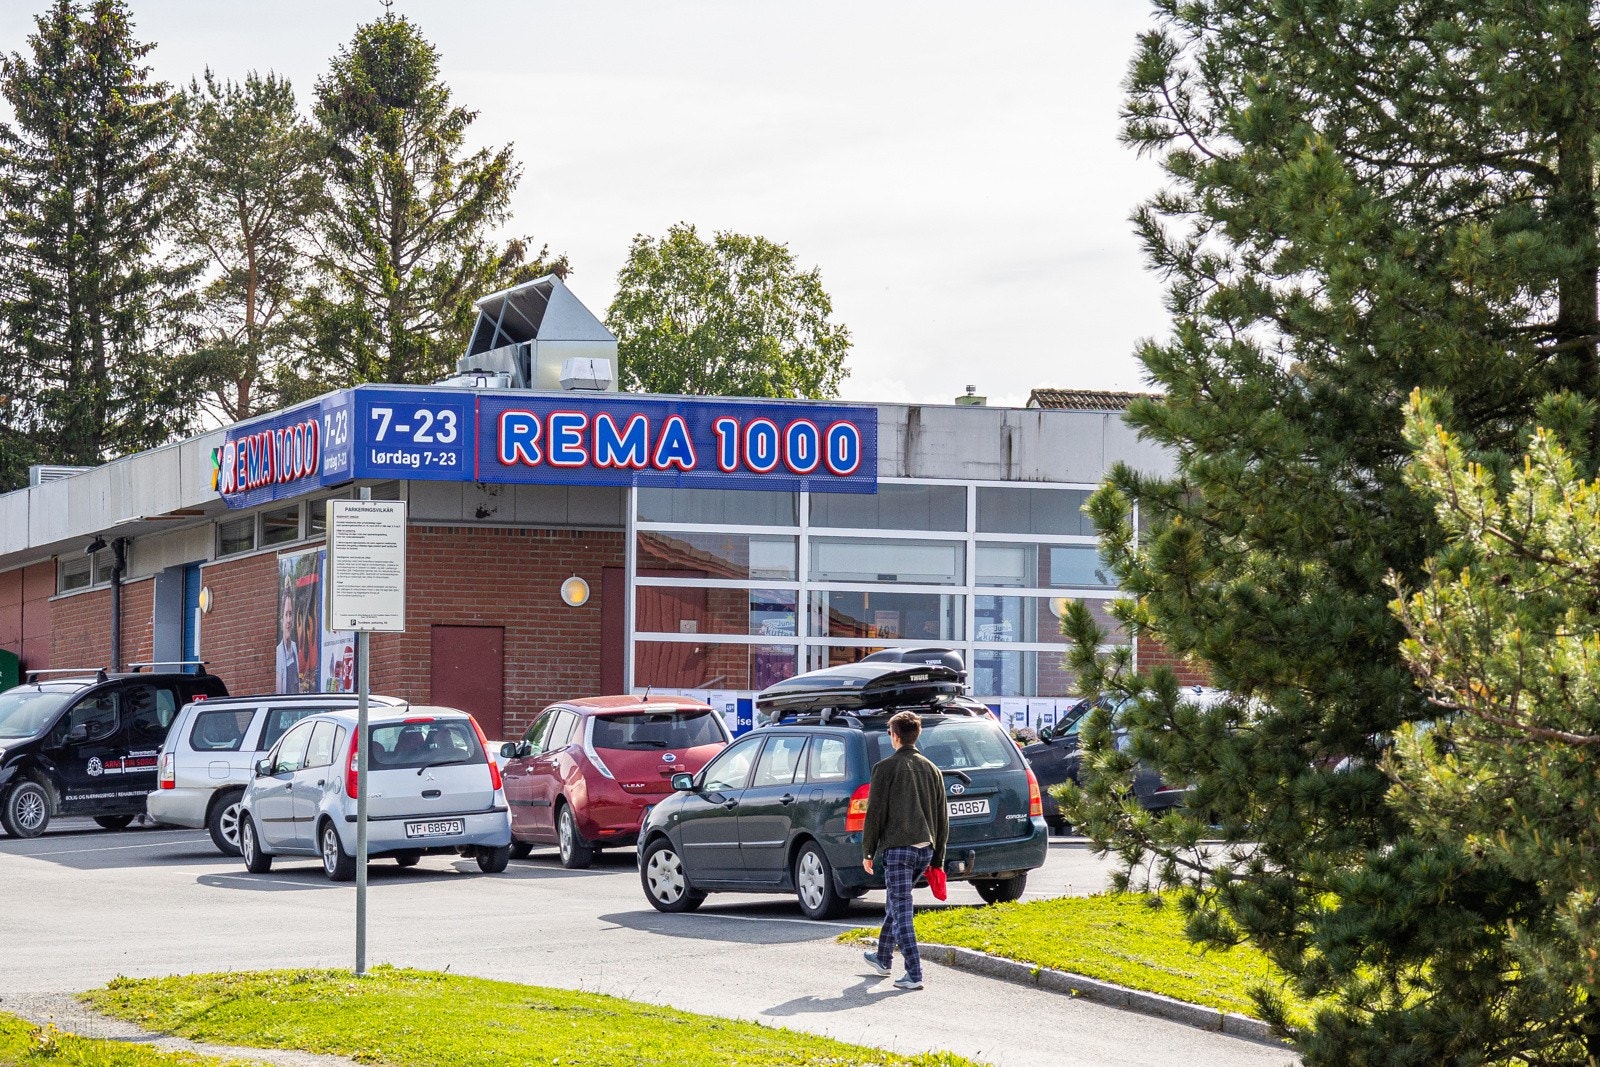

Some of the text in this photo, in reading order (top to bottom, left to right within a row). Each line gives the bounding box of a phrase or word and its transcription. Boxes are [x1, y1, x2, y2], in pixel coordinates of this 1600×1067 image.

[324, 409, 348, 448] 7-23
[371, 408, 457, 443] 7-23
[497, 409, 863, 476] REMA 1000
[221, 419, 320, 494] REMA 1000
[371, 449, 457, 467] lørdag 7-23
[909, 674, 929, 682] THULE
[950, 801, 986, 815] 64867
[410, 821, 459, 834] VF 68679
